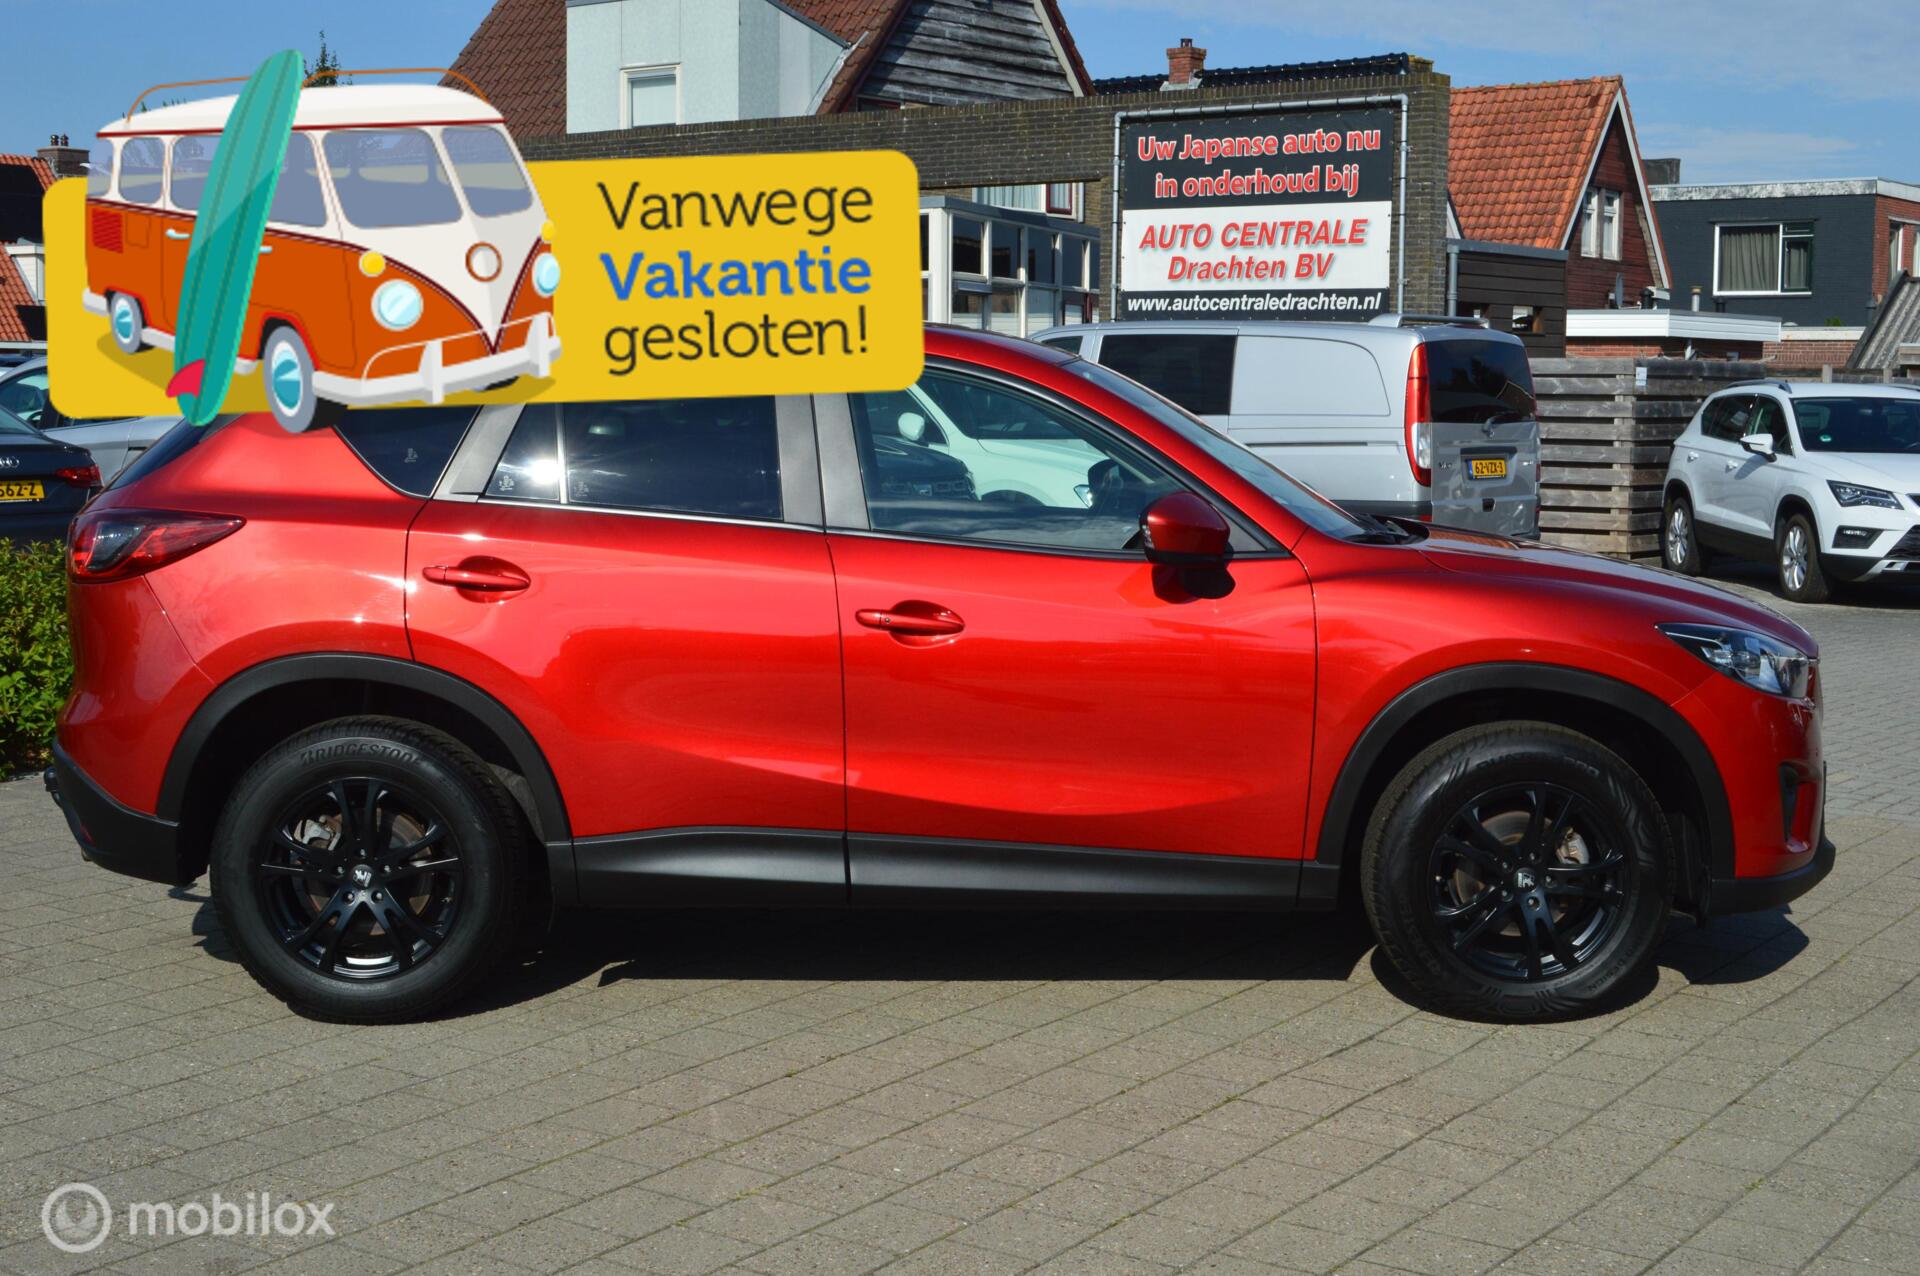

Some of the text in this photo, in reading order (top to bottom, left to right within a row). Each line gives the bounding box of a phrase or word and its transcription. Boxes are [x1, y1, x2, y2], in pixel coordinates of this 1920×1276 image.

[1138, 129, 1381, 164] Uw Japanse auto nu
[1155, 164, 1359, 197] in onderhoud bij
[1139, 218, 1369, 249] AUTO CENTRALE
[1168, 253, 1334, 280] Drachten BV
[1127, 292, 1382, 311] www.autocentraledrachten.nl
